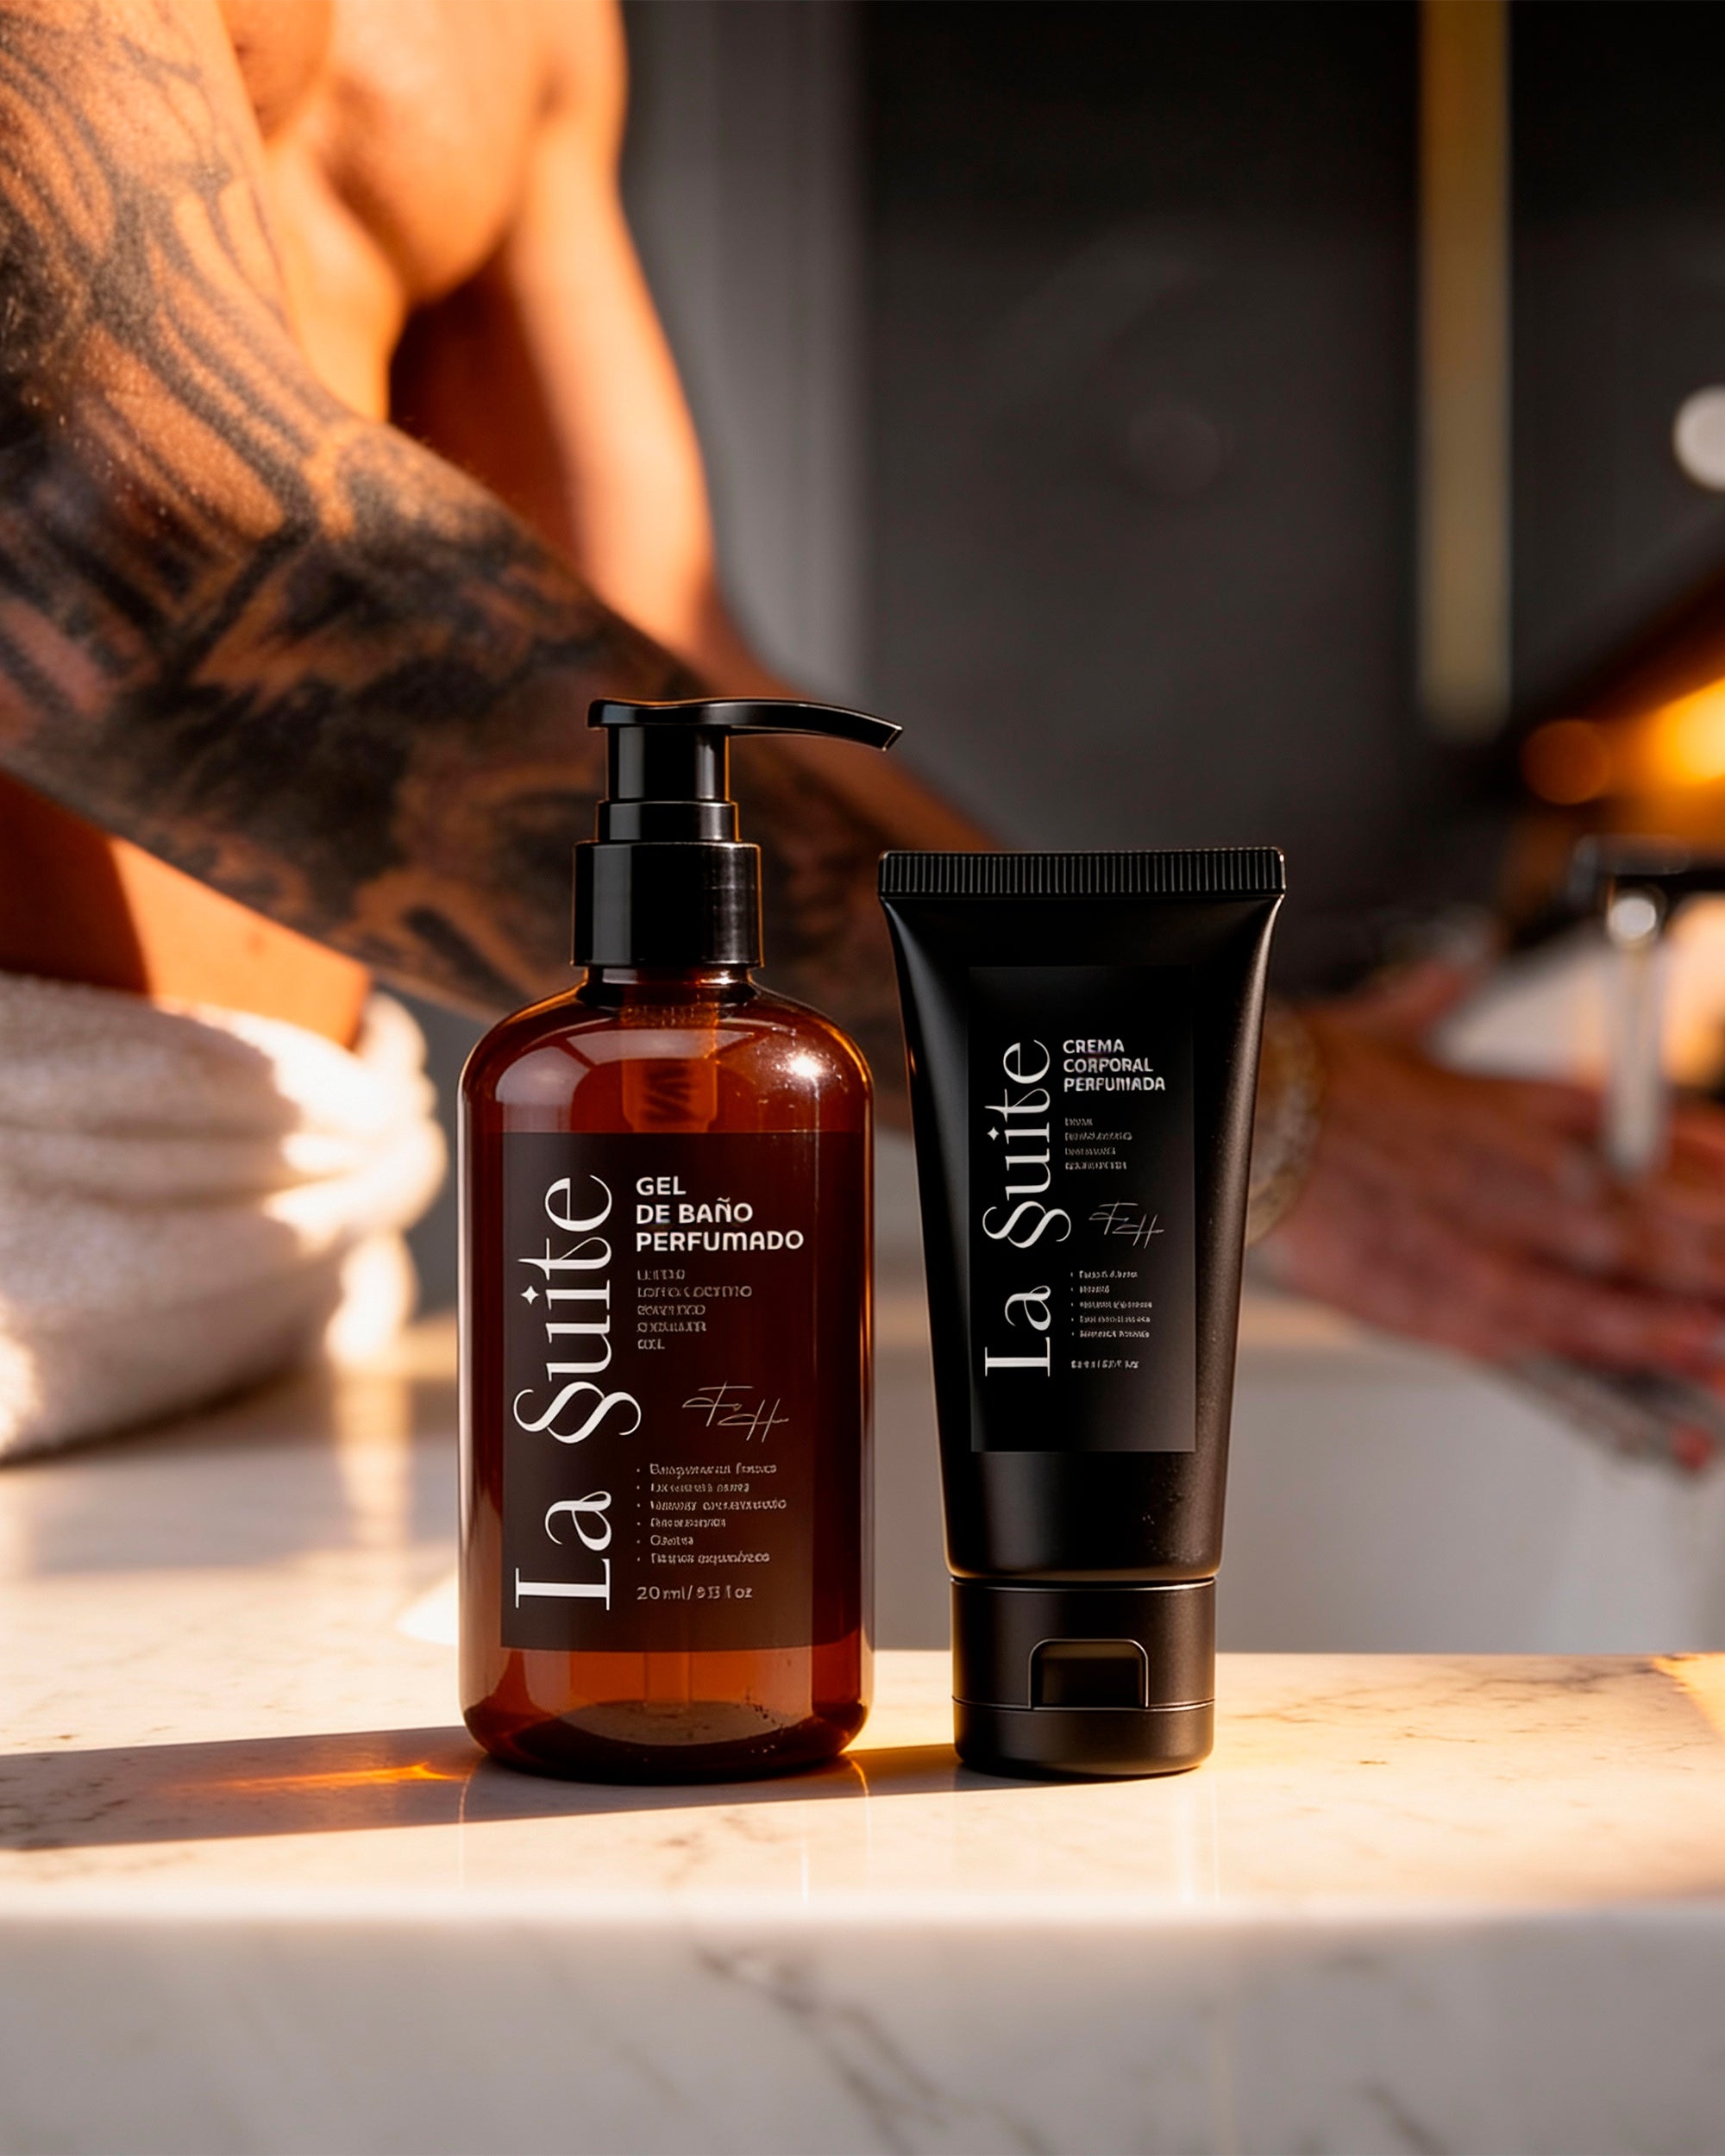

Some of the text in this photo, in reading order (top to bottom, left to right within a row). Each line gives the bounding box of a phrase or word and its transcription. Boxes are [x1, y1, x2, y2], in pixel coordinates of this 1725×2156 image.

[1063, 1038, 1125, 1054] CREMA
[1063, 1057, 1154, 1074] CORPORAL
[1063, 1076, 1166, 1093] PERFUMADA
[636, 1175, 687, 1196] GEL
[637, 1197, 754, 1225] DE BAÑO
[982, 1040, 1071, 1377] La Suite
[637, 1230, 805, 1252] PERFUMADO
[513, 1175, 642, 1611] La Suite
